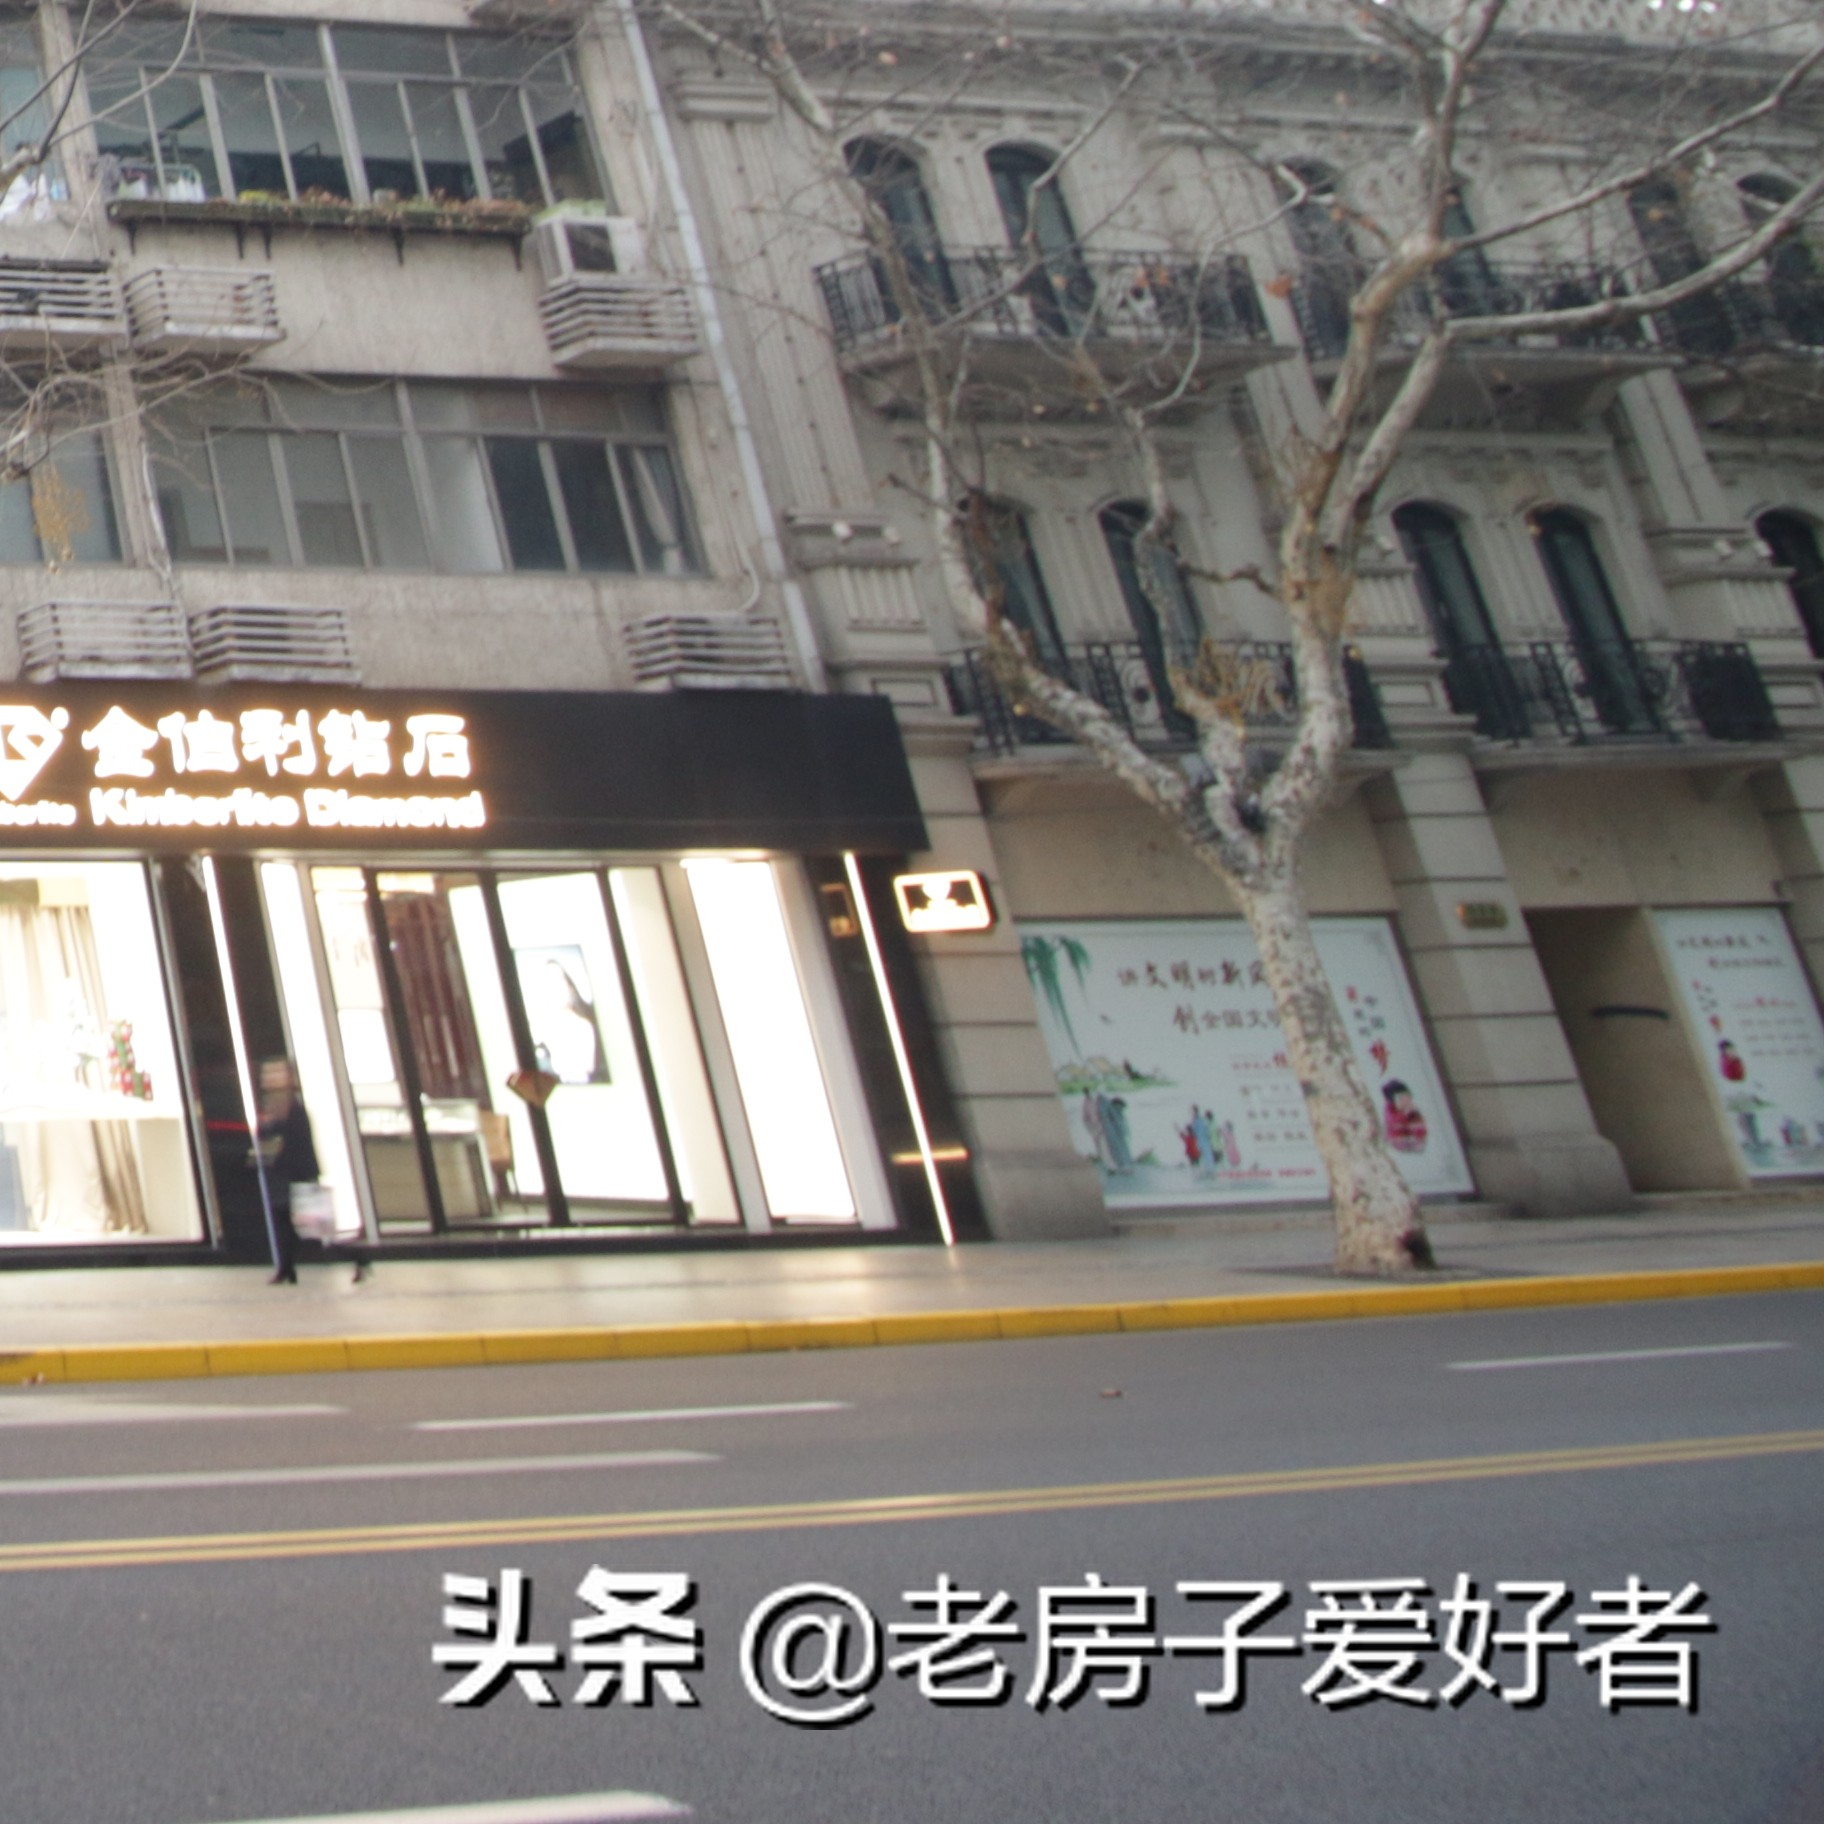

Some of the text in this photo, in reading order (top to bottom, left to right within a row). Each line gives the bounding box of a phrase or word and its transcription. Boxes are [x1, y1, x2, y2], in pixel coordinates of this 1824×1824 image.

[82, 707, 469, 777] 金伯利钻石
[304, 790, 484, 827] Diamond
